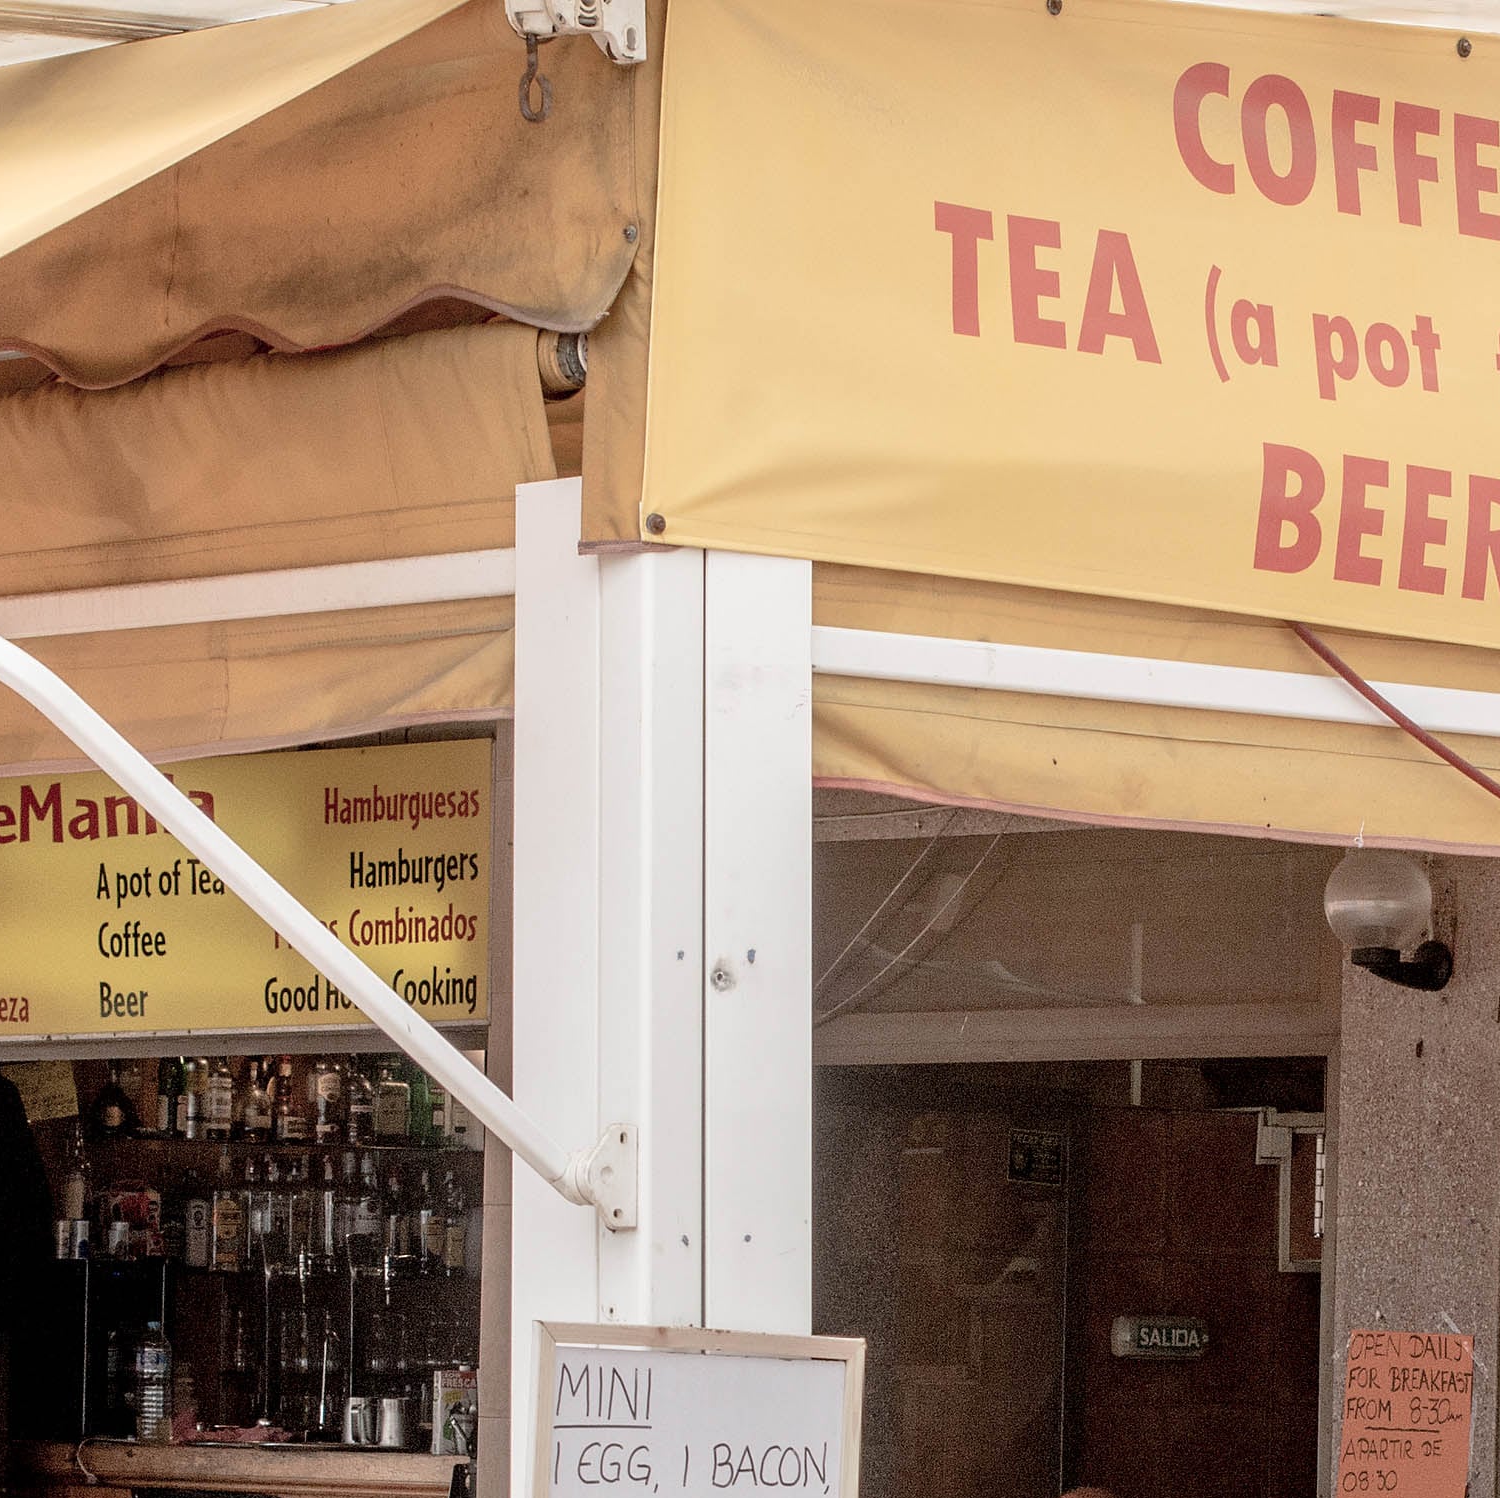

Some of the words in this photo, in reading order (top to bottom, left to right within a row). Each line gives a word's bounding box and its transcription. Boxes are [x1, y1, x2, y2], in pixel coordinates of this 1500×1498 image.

[935, 201, 1162, 363] TEA
[1205, 264, 1278, 383] (a
[1313, 313, 1442, 399] pot
[325, 785, 479, 829] Hamburguesas
[97, 863, 110, 899] A
[116, 867, 151, 908] pot
[159, 859, 181, 895] of
[187, 859, 225, 895] Tea
[350, 849, 478, 892] Hamburgers
[98, 921, 167, 958] Coffee
[349, 904, 477, 946] Combinados
[100, 982, 148, 1018] Beer
[265, 975, 319, 1014] Good
[1139, 1327, 1200, 1348] SALIDA
[1350, 1333, 1400, 1361] OPEN
[1409, 1335, 1463, 1361] DAILY
[557, 1364, 652, 1421] MINI
[1348, 1366, 1381, 1390] FOR
[1389, 1366, 1473, 1393] BREAKFAST
[1346, 1397, 1392, 1422] FROM
[1422, 1439, 1443, 1457] DE
[577, 1442, 661, 1493] EGG,
[713, 1442, 831, 1494] BACON,
